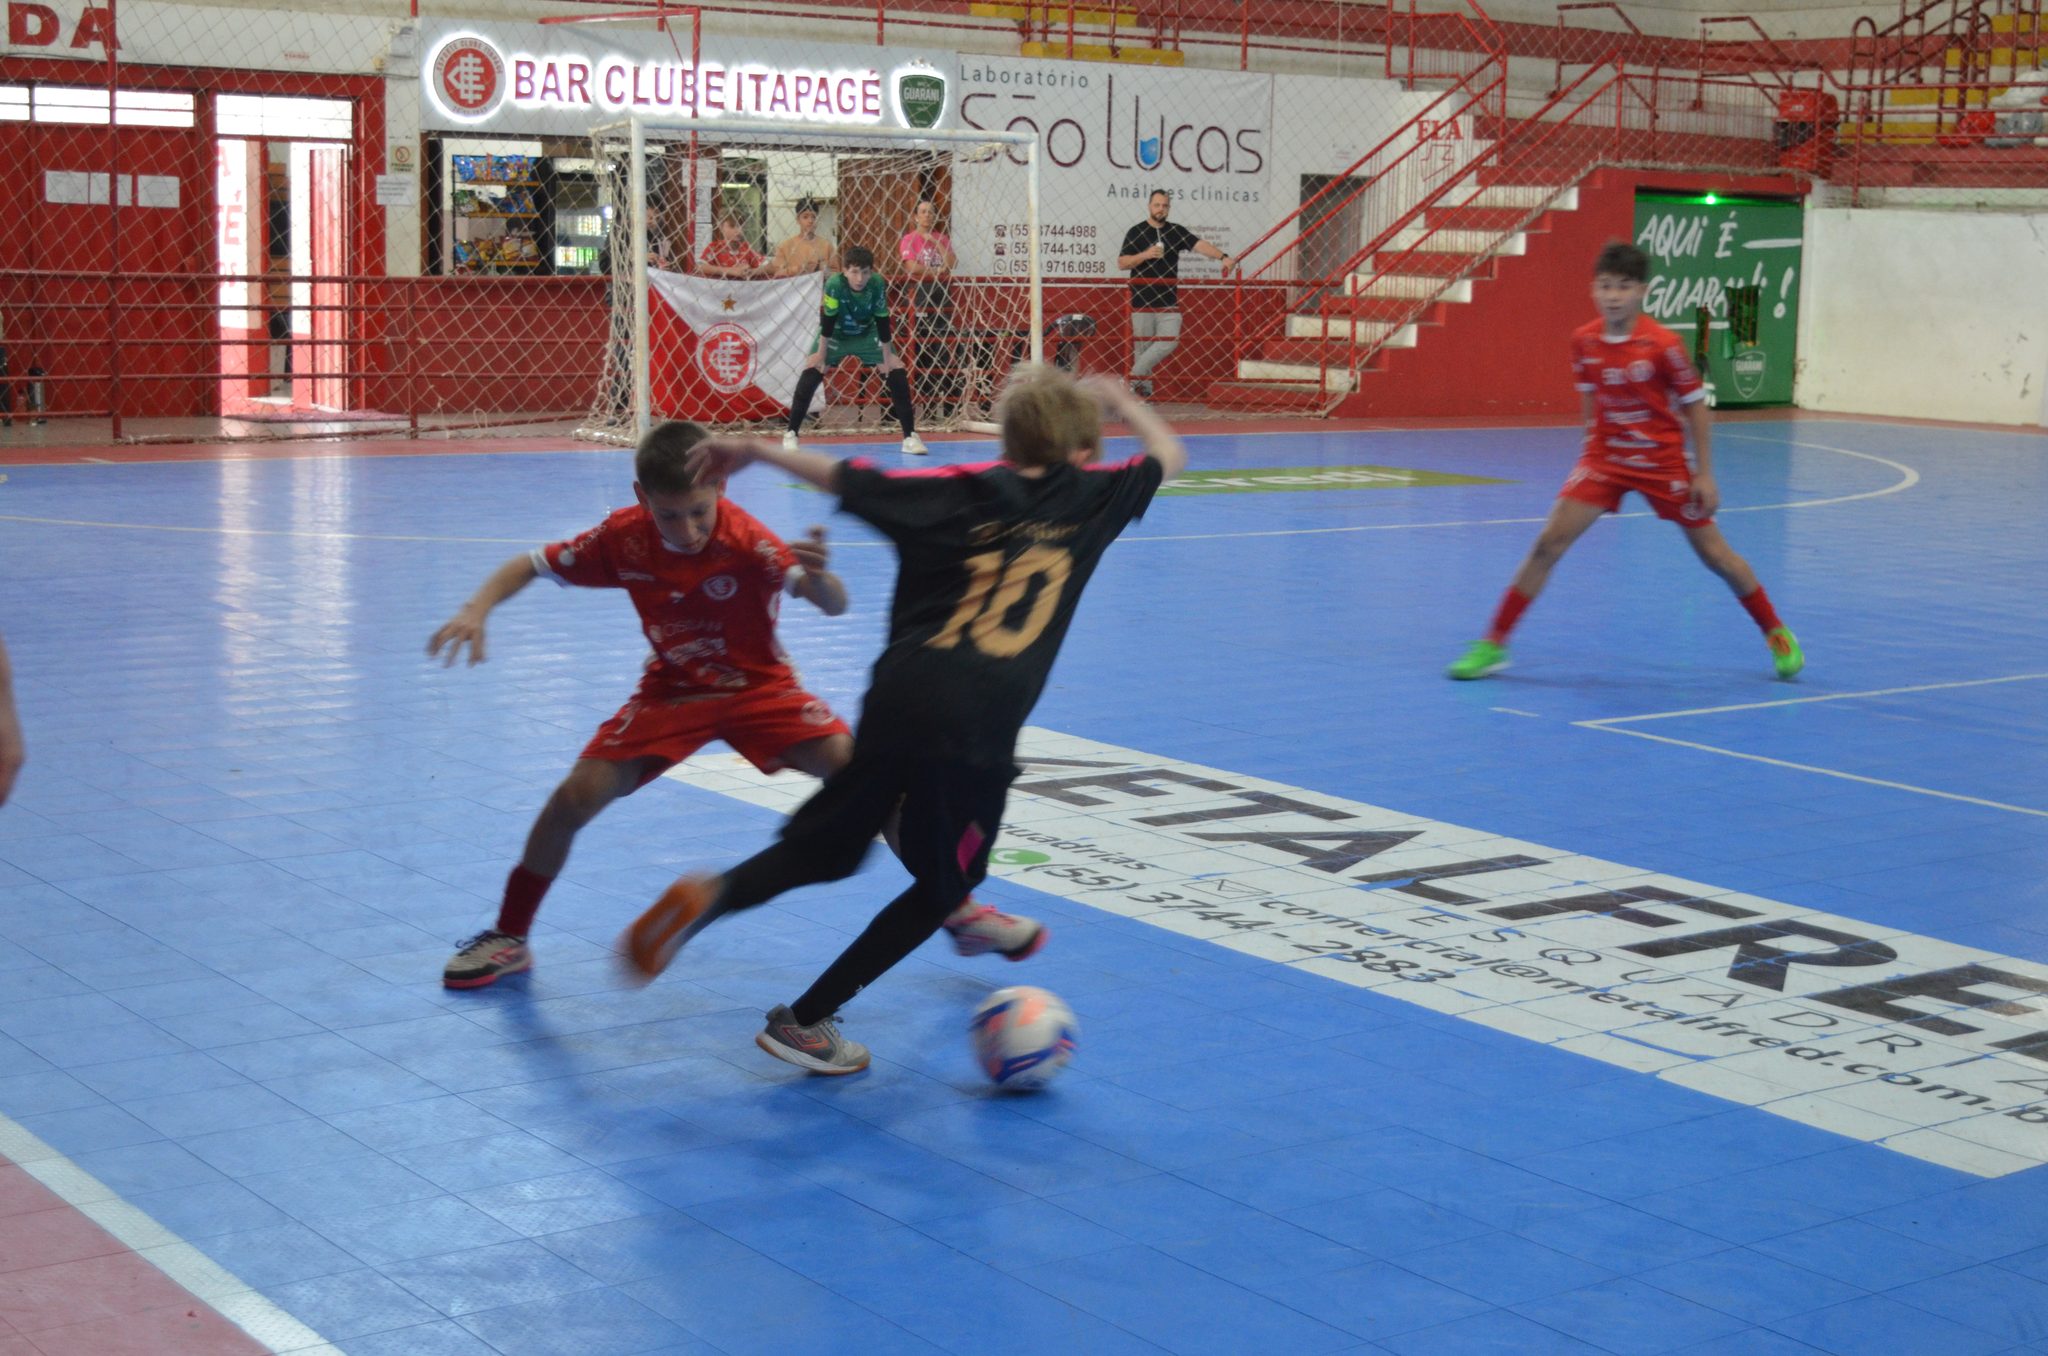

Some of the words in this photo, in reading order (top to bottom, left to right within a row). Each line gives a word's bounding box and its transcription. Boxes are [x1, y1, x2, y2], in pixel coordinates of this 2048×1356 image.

[514, 59, 592, 104] BAR
[605, 64, 726, 110] CLUBE
[735, 69, 881, 117] ITAPAGÉ
[959, 64, 1090, 89] Laboratório
[1190, 184, 1261, 204] clínicas
[921, 546, 1073, 659] 10
[1008, 756, 2048, 1063] ETALFRE
[1022, 863, 1142, 892] (55)
[1126, 890, 1275, 931] 3744
[1290, 938, 1457, 983] 2883
